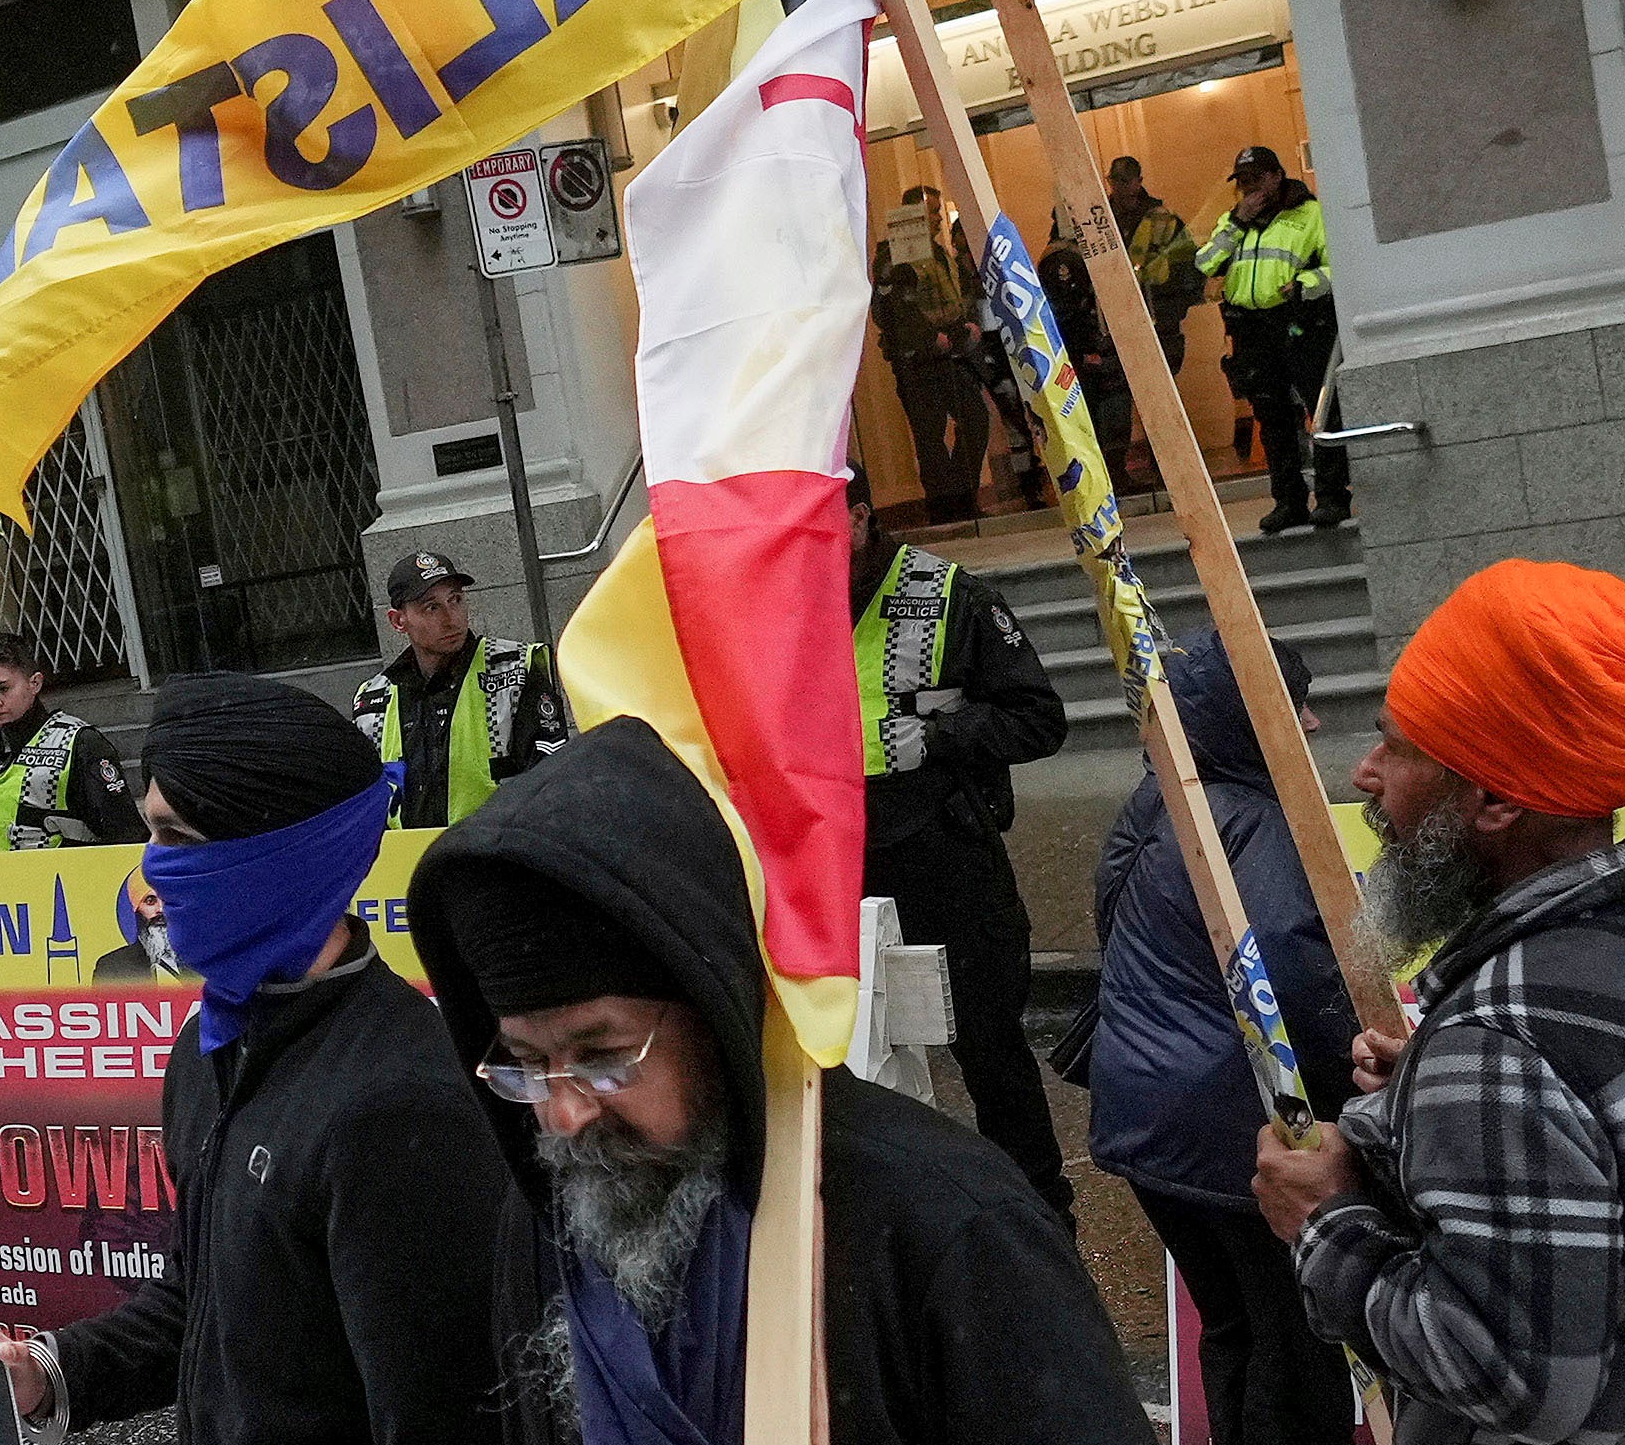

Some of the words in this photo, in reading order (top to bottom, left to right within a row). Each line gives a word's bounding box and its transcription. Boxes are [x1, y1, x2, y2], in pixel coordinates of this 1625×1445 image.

[489, 227, 500, 235] No
[502, 222, 538, 234] Stopping
[501, 232, 529, 242] Anytime
[888, 598, 940, 607] VANCOUVER
[887, 606, 940, 617] POLICE
[16, 754, 65, 767] POLICE
[69, 1240, 94, 1275] of
[101, 1241, 165, 1280] India
